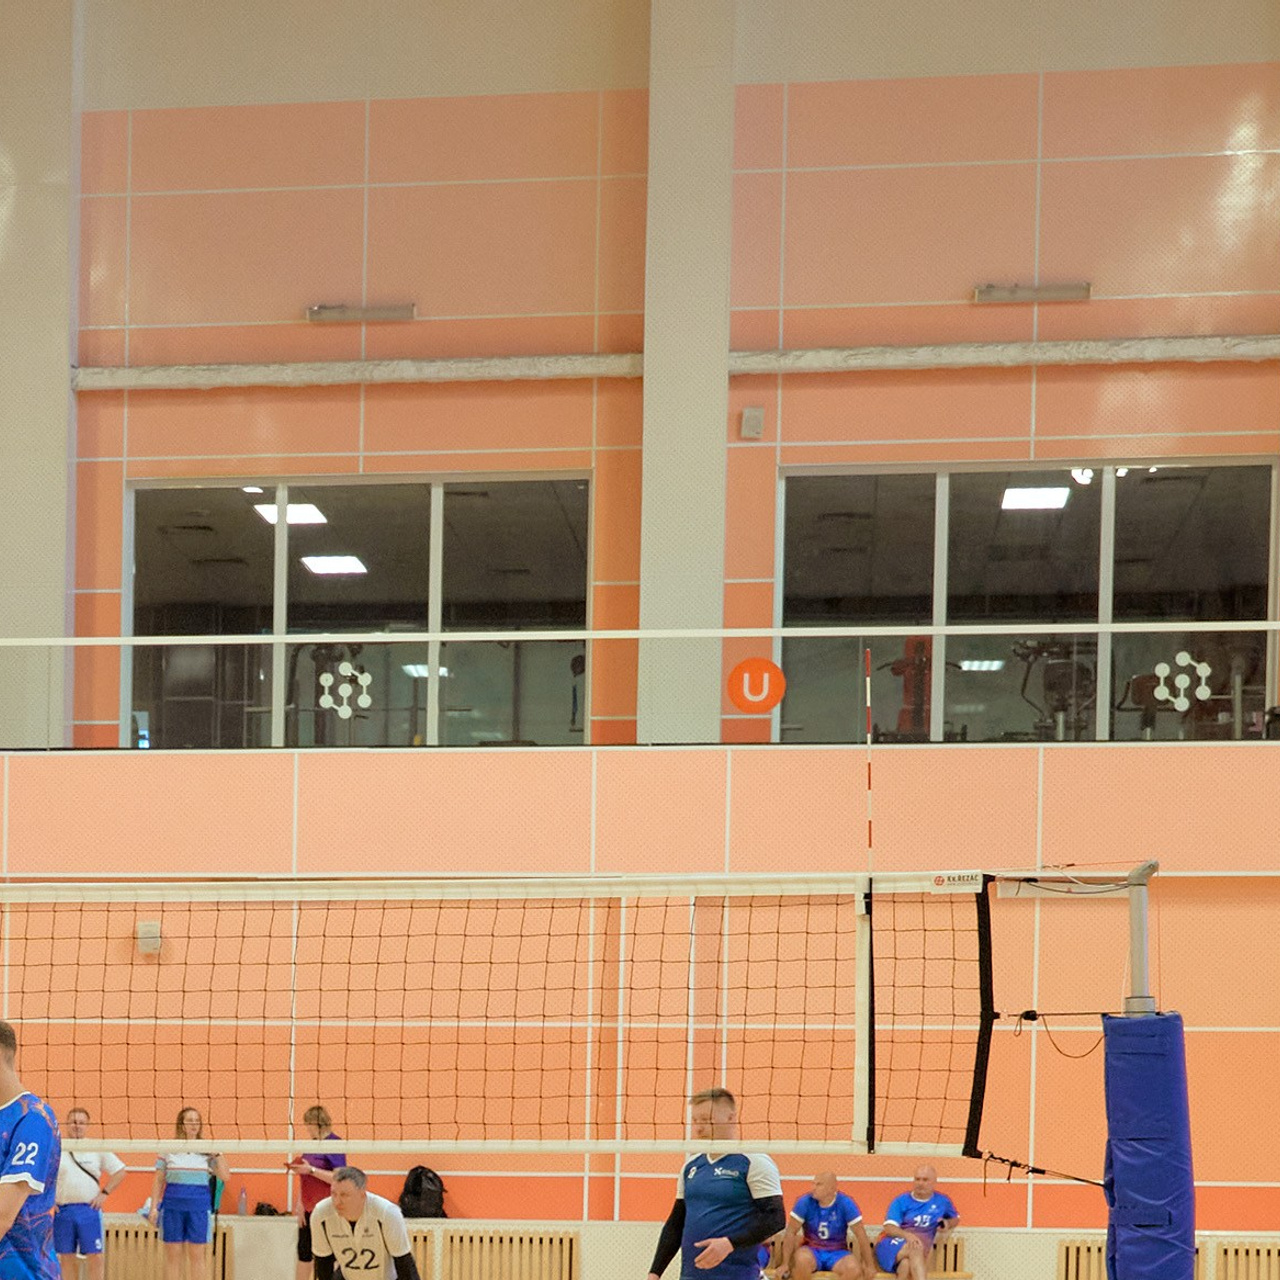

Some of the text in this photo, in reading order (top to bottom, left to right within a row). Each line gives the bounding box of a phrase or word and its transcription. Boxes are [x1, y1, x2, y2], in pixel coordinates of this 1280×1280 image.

[743, 672, 769, 702] U
[12, 1142, 39, 1167] 22
[818, 1222, 830, 1240] 5
[341, 1247, 380, 1270] 22
